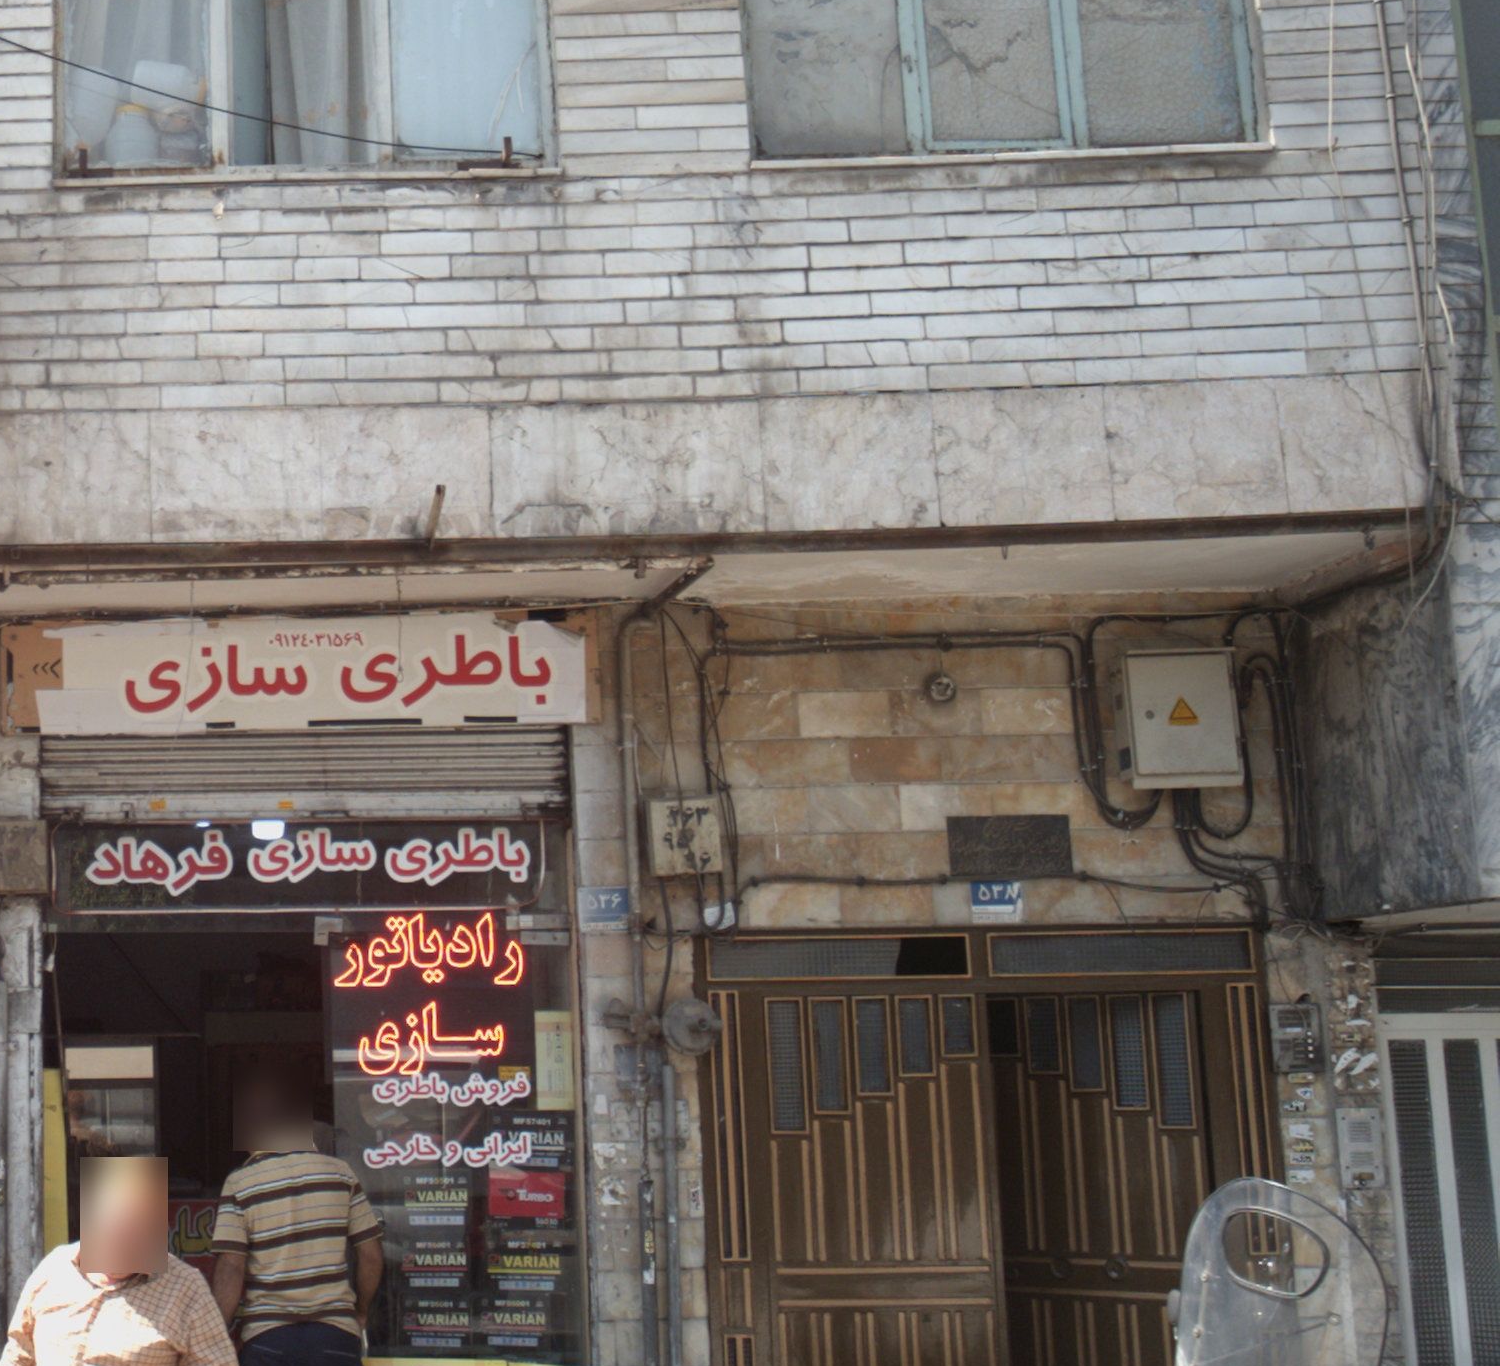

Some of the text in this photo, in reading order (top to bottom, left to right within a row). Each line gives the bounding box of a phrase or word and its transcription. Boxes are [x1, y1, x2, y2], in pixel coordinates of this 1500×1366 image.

[124, 634, 552, 714] باطری سازی
[87, 828, 530, 896] باطری سازی فرهاد
[334, 912, 524, 987] رادیاتور
[357, 1001, 505, 1075] سازی
[373, 1073, 531, 1106] فروش باطری
[508, 1130, 565, 1146] VRIAN
[363, 1133, 532, 1168] ایرانی و خارجی
[417, 1189, 468, 1203] VARIAN
[415, 1252, 467, 1266] VARIAN
[503, 1255, 560, 1268] VARIAN
[417, 1312, 469, 1326] VARIAN
[494, 1311, 546, 1325] VARIAN
